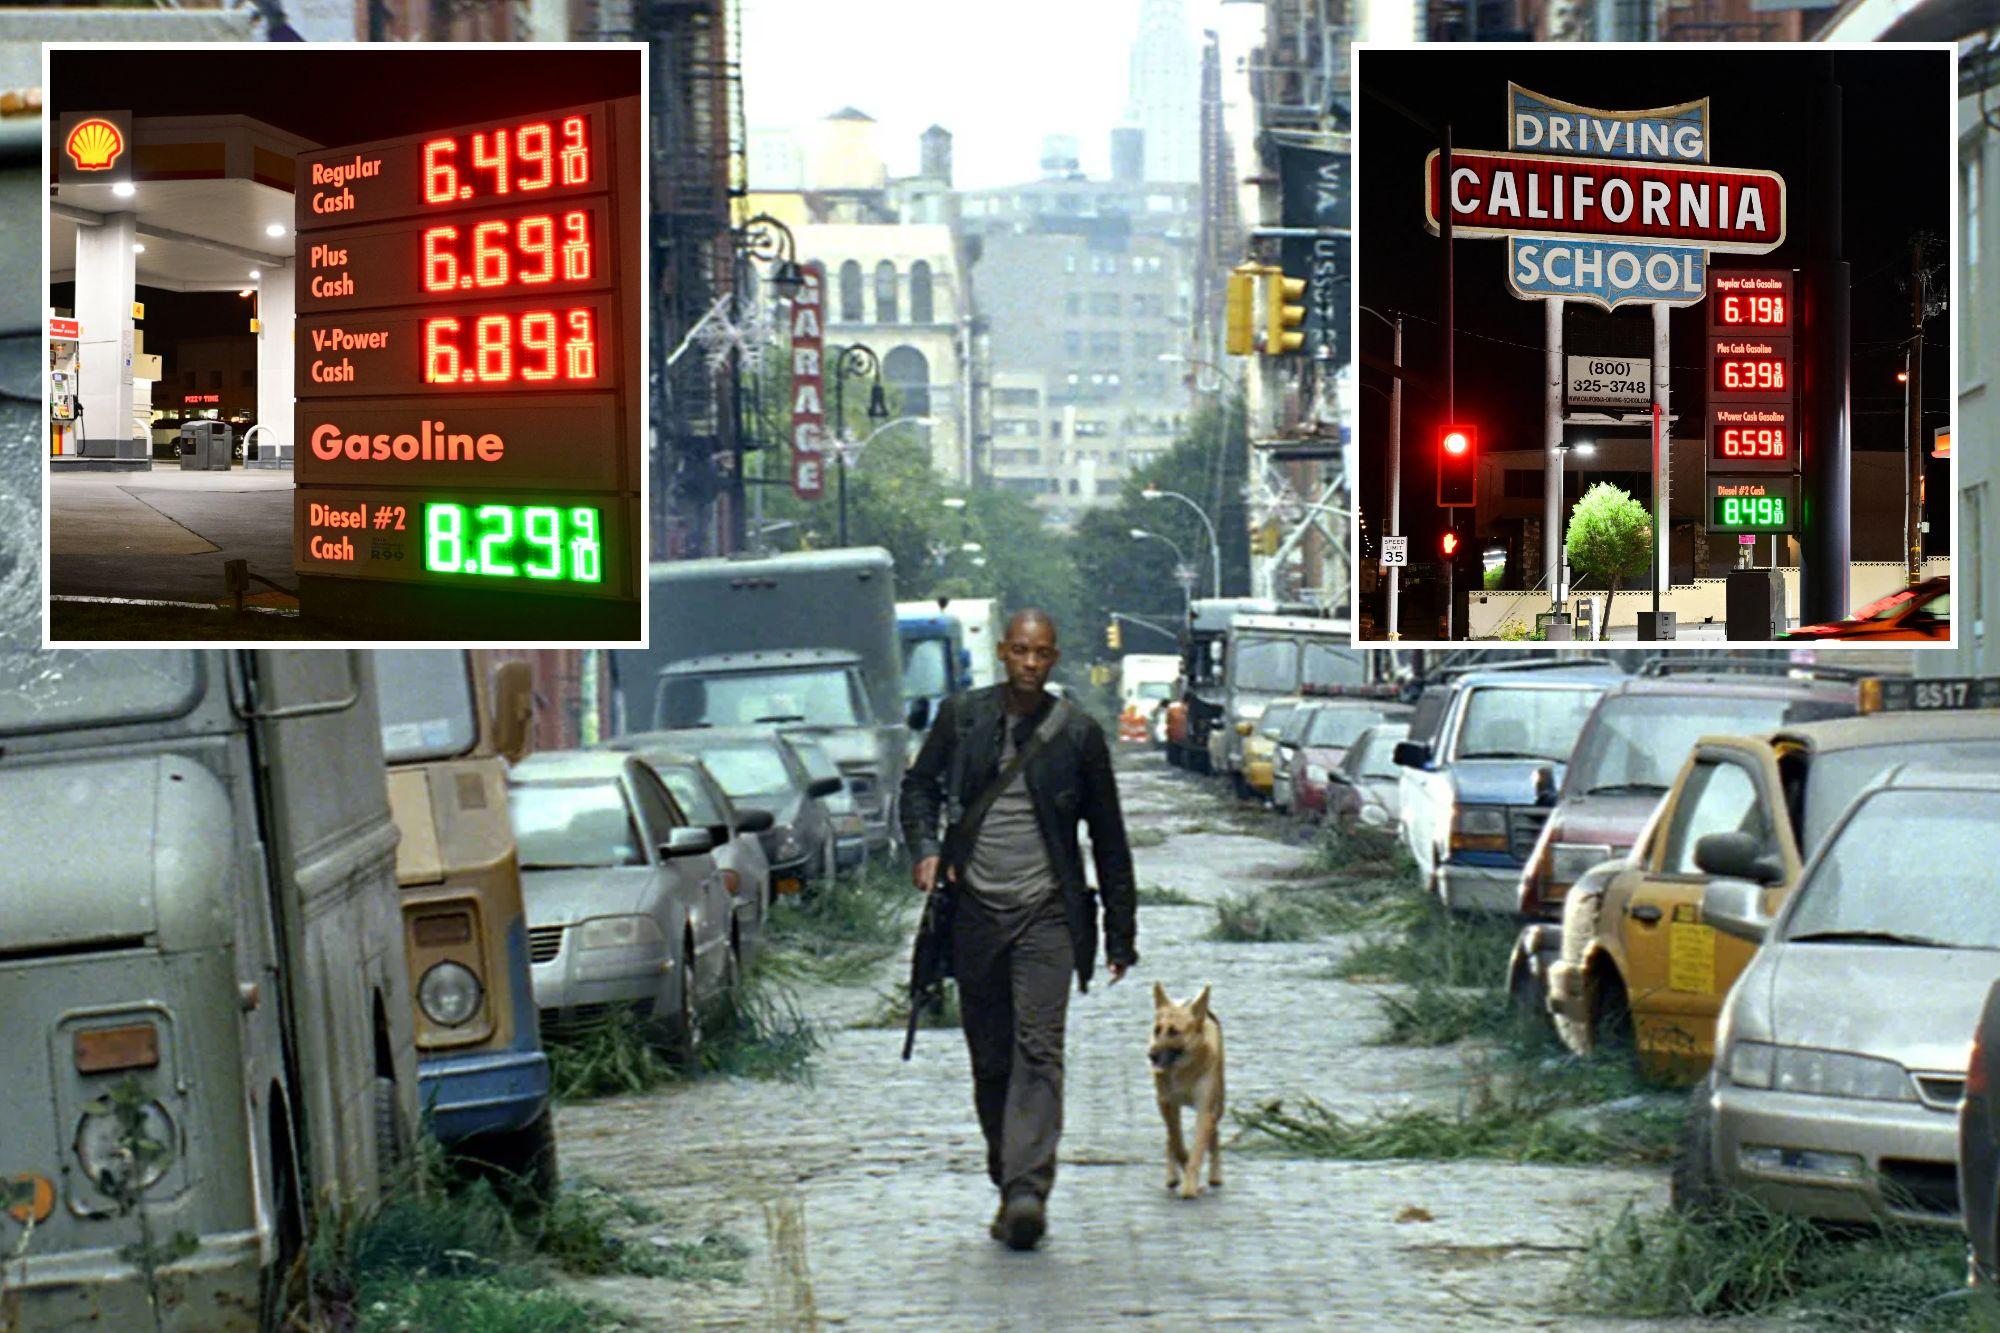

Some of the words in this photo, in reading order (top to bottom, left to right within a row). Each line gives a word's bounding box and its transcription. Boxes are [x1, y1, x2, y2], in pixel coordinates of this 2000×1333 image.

[1516, 114, 1703, 158] DRIVING
[312, 155, 382, 187] Regular
[424, 124, 551, 203] 6.49
[312, 188, 355, 214] Cash
[1316, 163, 1340, 215] VIA
[1451, 167, 1766, 231] CALIFORNIA
[311, 244, 348, 268] Plus
[424, 216, 553, 291] 6.69
[1516, 246, 1701, 293] SCHOOL
[311, 272, 354, 298] Cash
[1717, 278, 1740, 290] Regular
[1741, 278, 1755, 289] Cash
[1756, 278, 1782, 289] Gasoline
[1724, 297, 1772, 323] 6.19
[311, 328, 389, 352] V-Power
[427, 312, 556, 383] 6.89
[1717, 343, 1730, 353] Plus
[1731, 343, 1745, 353] Cash
[1745, 343, 1772, 353] Gasoline
[311, 358, 354, 382] Cash
[1589, 361, 1630, 376] (800)
[1724, 362, 1772, 388] 6.39
[1573, 379, 1646, 393] 325-3748
[1717, 411, 1742, 421] V-Power
[1743, 411, 1757, 421] Cash
[1758, 411, 1784, 421] Gasoline
[311, 420, 504, 461] Gasoline
[1724, 430, 1772, 456] 6.59
[1718, 486, 1737, 496] Diesel
[1739, 486, 1749, 496] #2
[1750, 486, 1765, 495] Cash
[310, 503, 367, 529] Diesel
[373, 506, 406, 531] #2
[1724, 498, 1772, 524] 8.49
[310, 535, 354, 561] Cash
[428, 504, 561, 577] 8.29
[1385, 551, 1404, 562] 35
